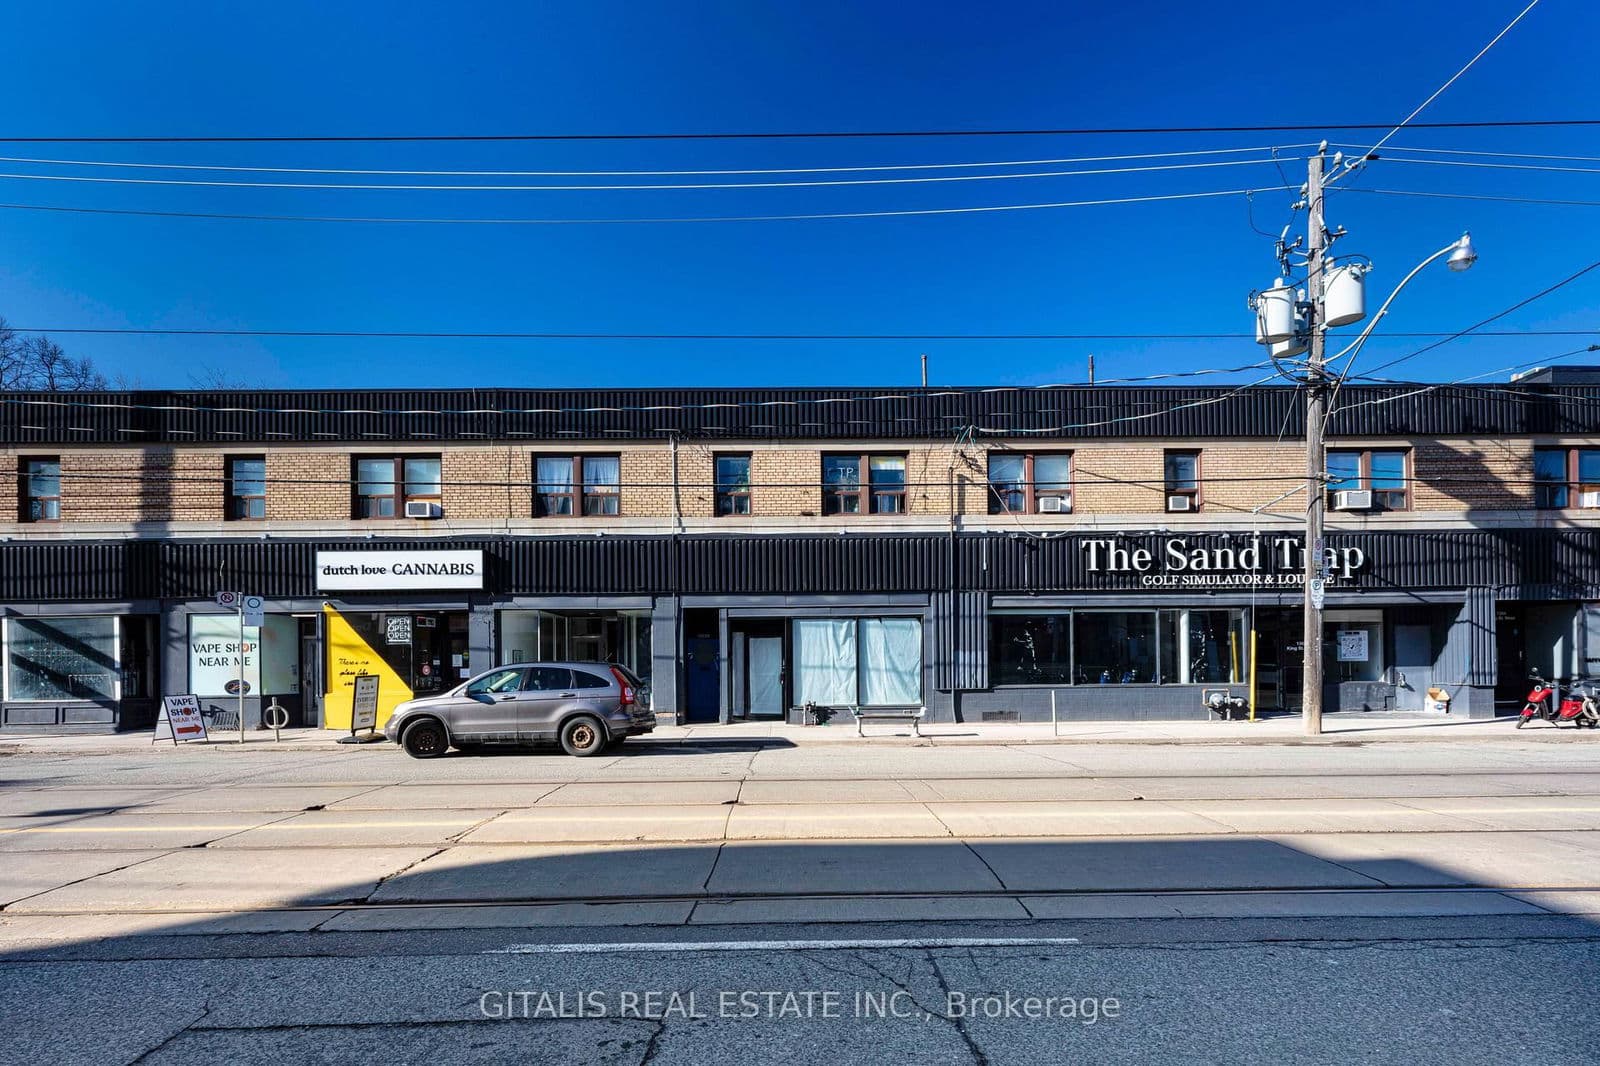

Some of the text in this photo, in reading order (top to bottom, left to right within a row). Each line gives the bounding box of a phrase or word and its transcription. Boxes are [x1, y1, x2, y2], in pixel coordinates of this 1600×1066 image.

[1082, 539, 1152, 571] The
[1166, 538, 1262, 571] Sand
[323, 563, 474, 576] dutch love CANNABIS
[1142, 574, 1335, 586] GOLF SIMULATOR & LOUE
[193, 643, 257, 653] VAPE SHOP
[199, 657, 229, 666] NEAR
[170, 698, 194, 706] VAPE
[171, 707, 197, 716] SHOP
